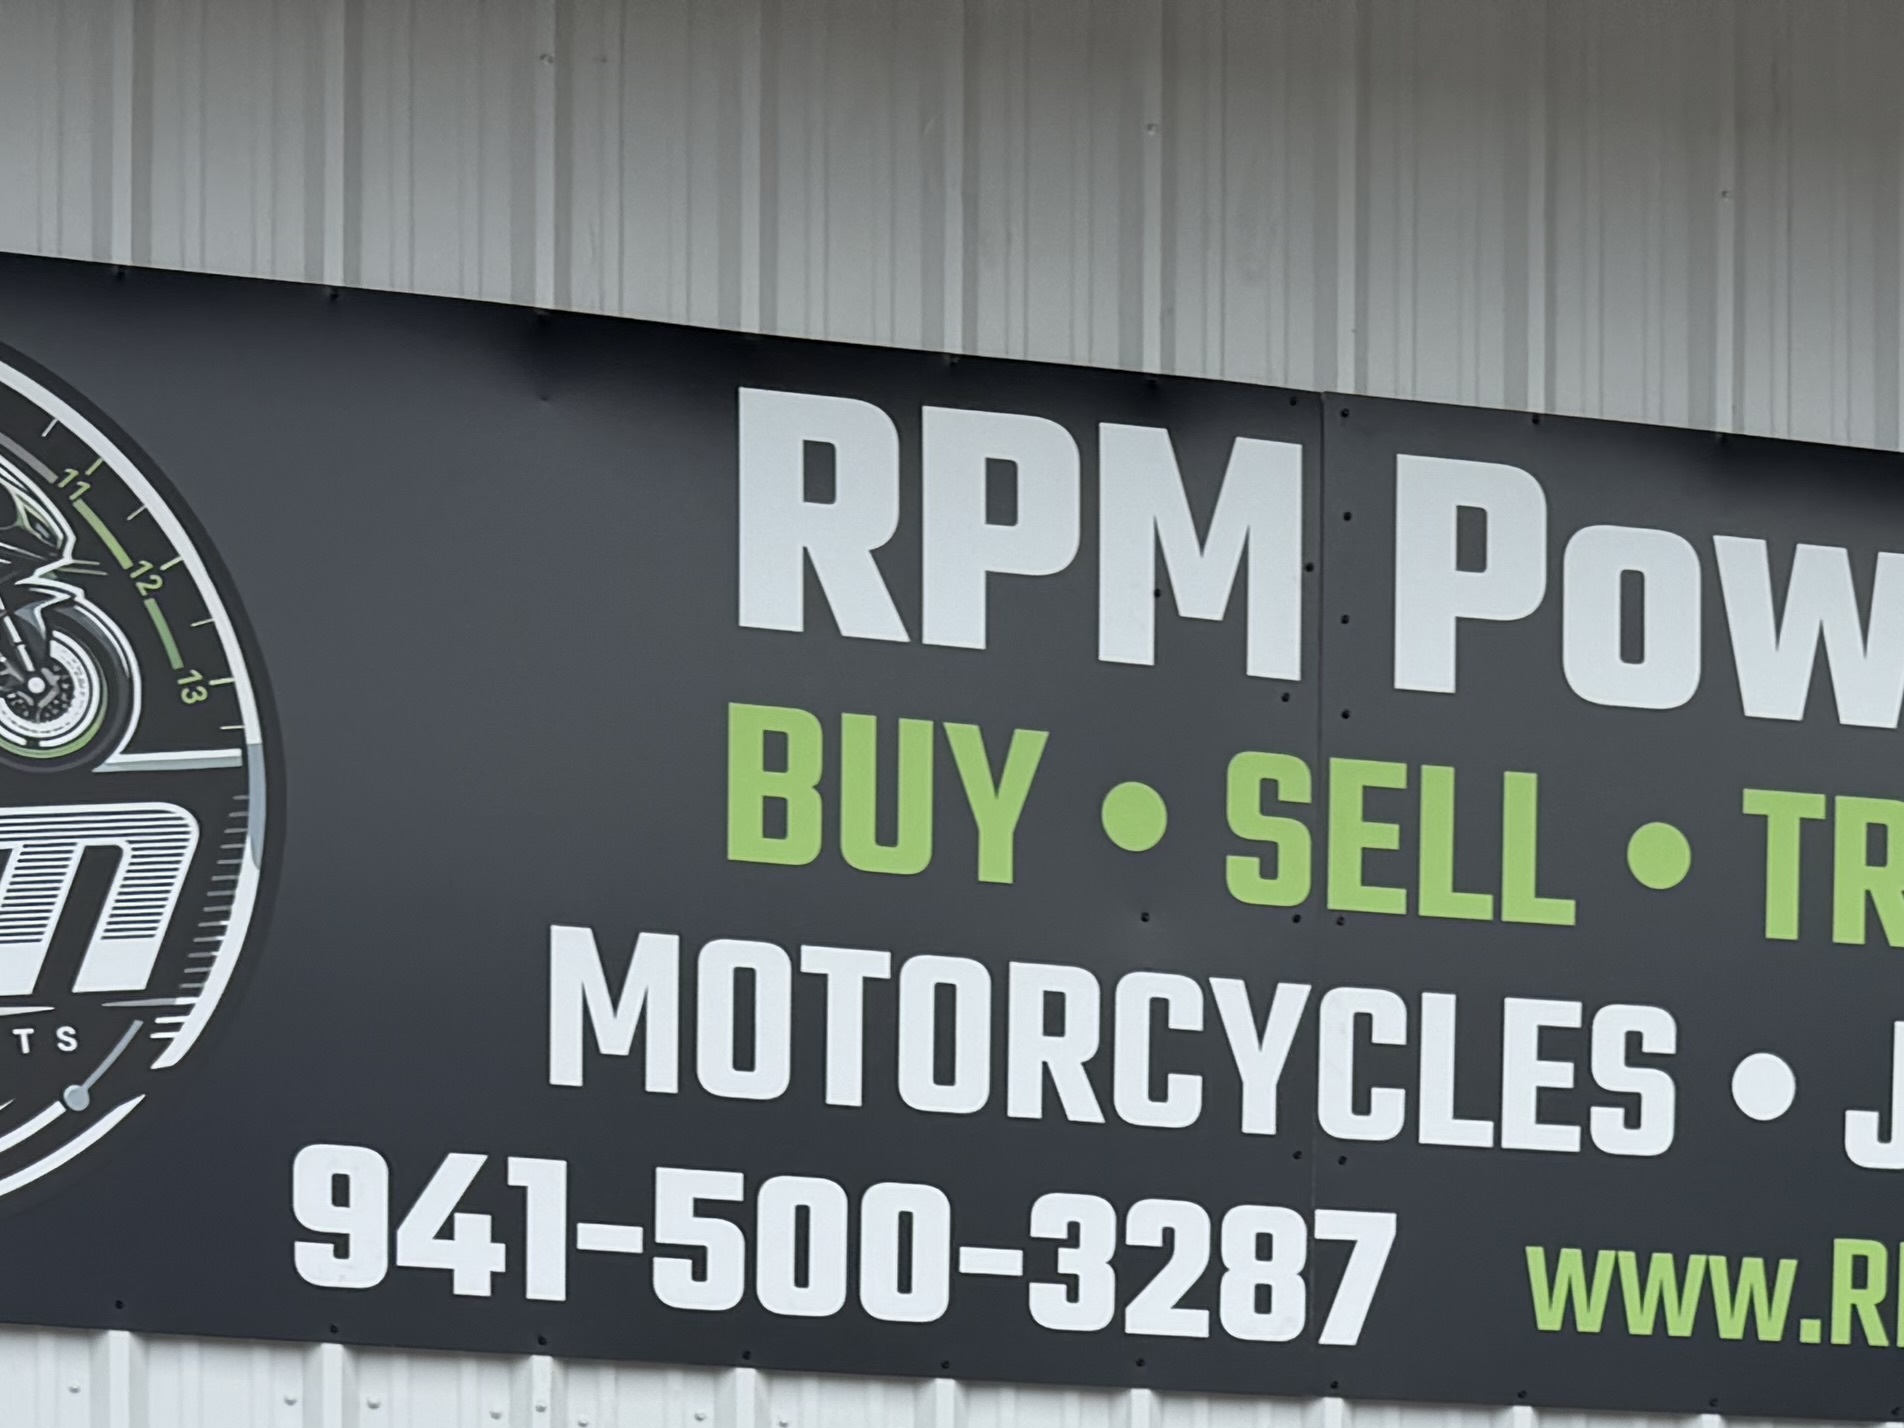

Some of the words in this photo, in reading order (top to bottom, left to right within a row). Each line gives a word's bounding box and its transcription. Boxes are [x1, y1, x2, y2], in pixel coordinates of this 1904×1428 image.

[58, 469, 91, 501] 11
[130, 561, 164, 596] 12
[178, 669, 208, 705] 13
[738, 386, 1303, 682] RPM
[728, 702, 1049, 884] BUY
[1226, 751, 1576, 926] SELL
[549, 924, 1677, 1157] MOTORCYCLES
[293, 1143, 1398, 1347] 941-500-3287
